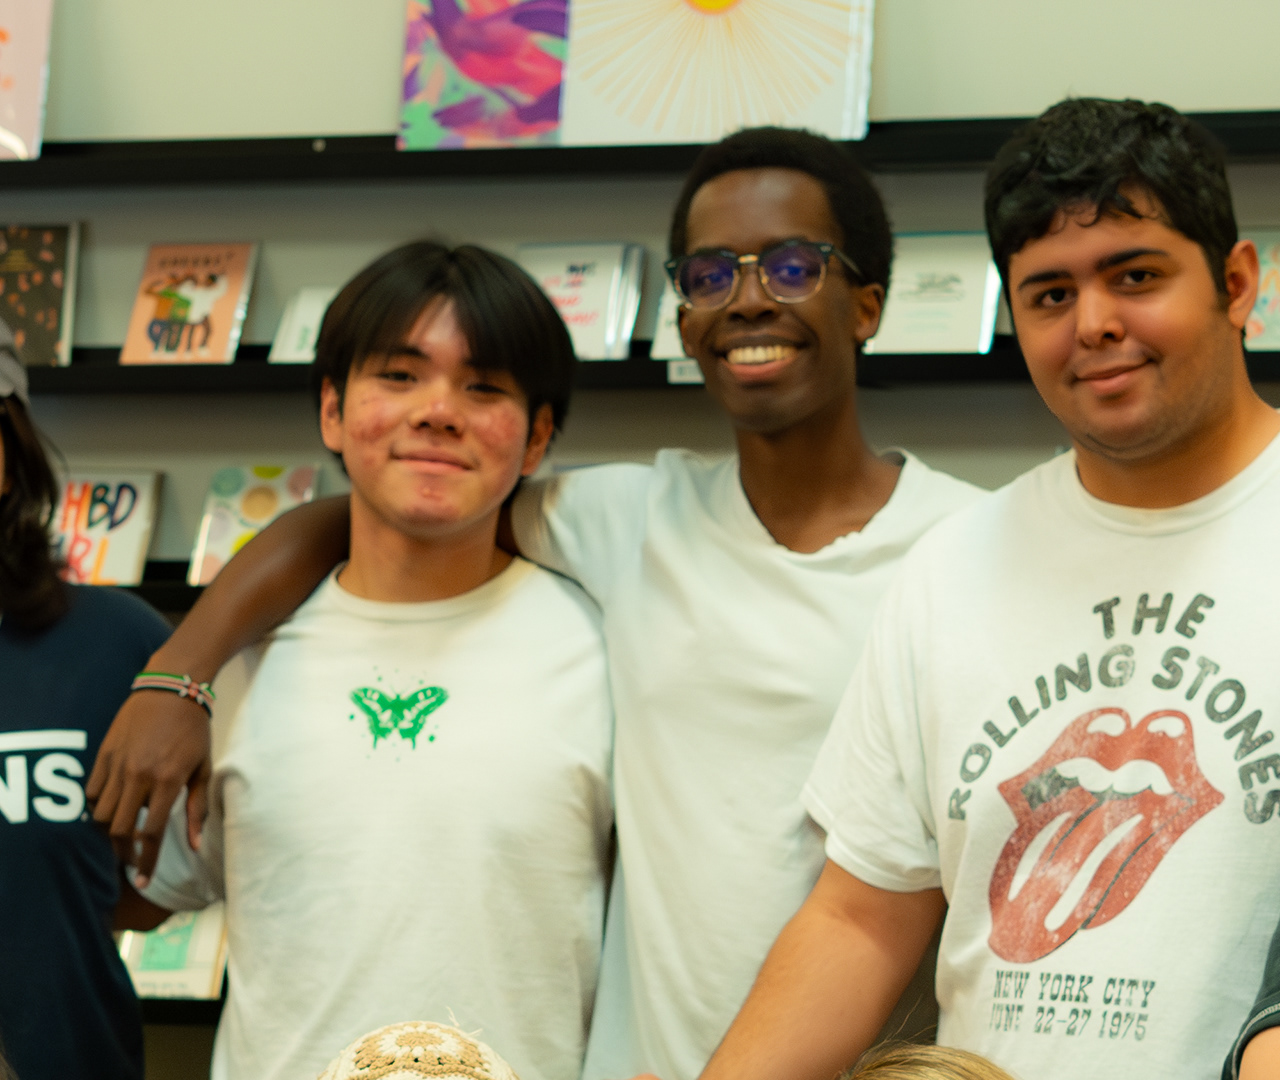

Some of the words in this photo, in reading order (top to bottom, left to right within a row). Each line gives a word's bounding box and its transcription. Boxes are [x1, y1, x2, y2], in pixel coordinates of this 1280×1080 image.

[60, 481, 137, 531] HBD
[1093, 592, 1214, 640] THE
[948, 644, 1136, 821] ROLLING
[993, 969, 1031, 999] NEW
[1037, 972, 1095, 1004] YORK
[1103, 977, 1157, 1009] CITY
[1034, 1006, 1093, 1037] 22-27
[1098, 1010, 1150, 1042] 1975
